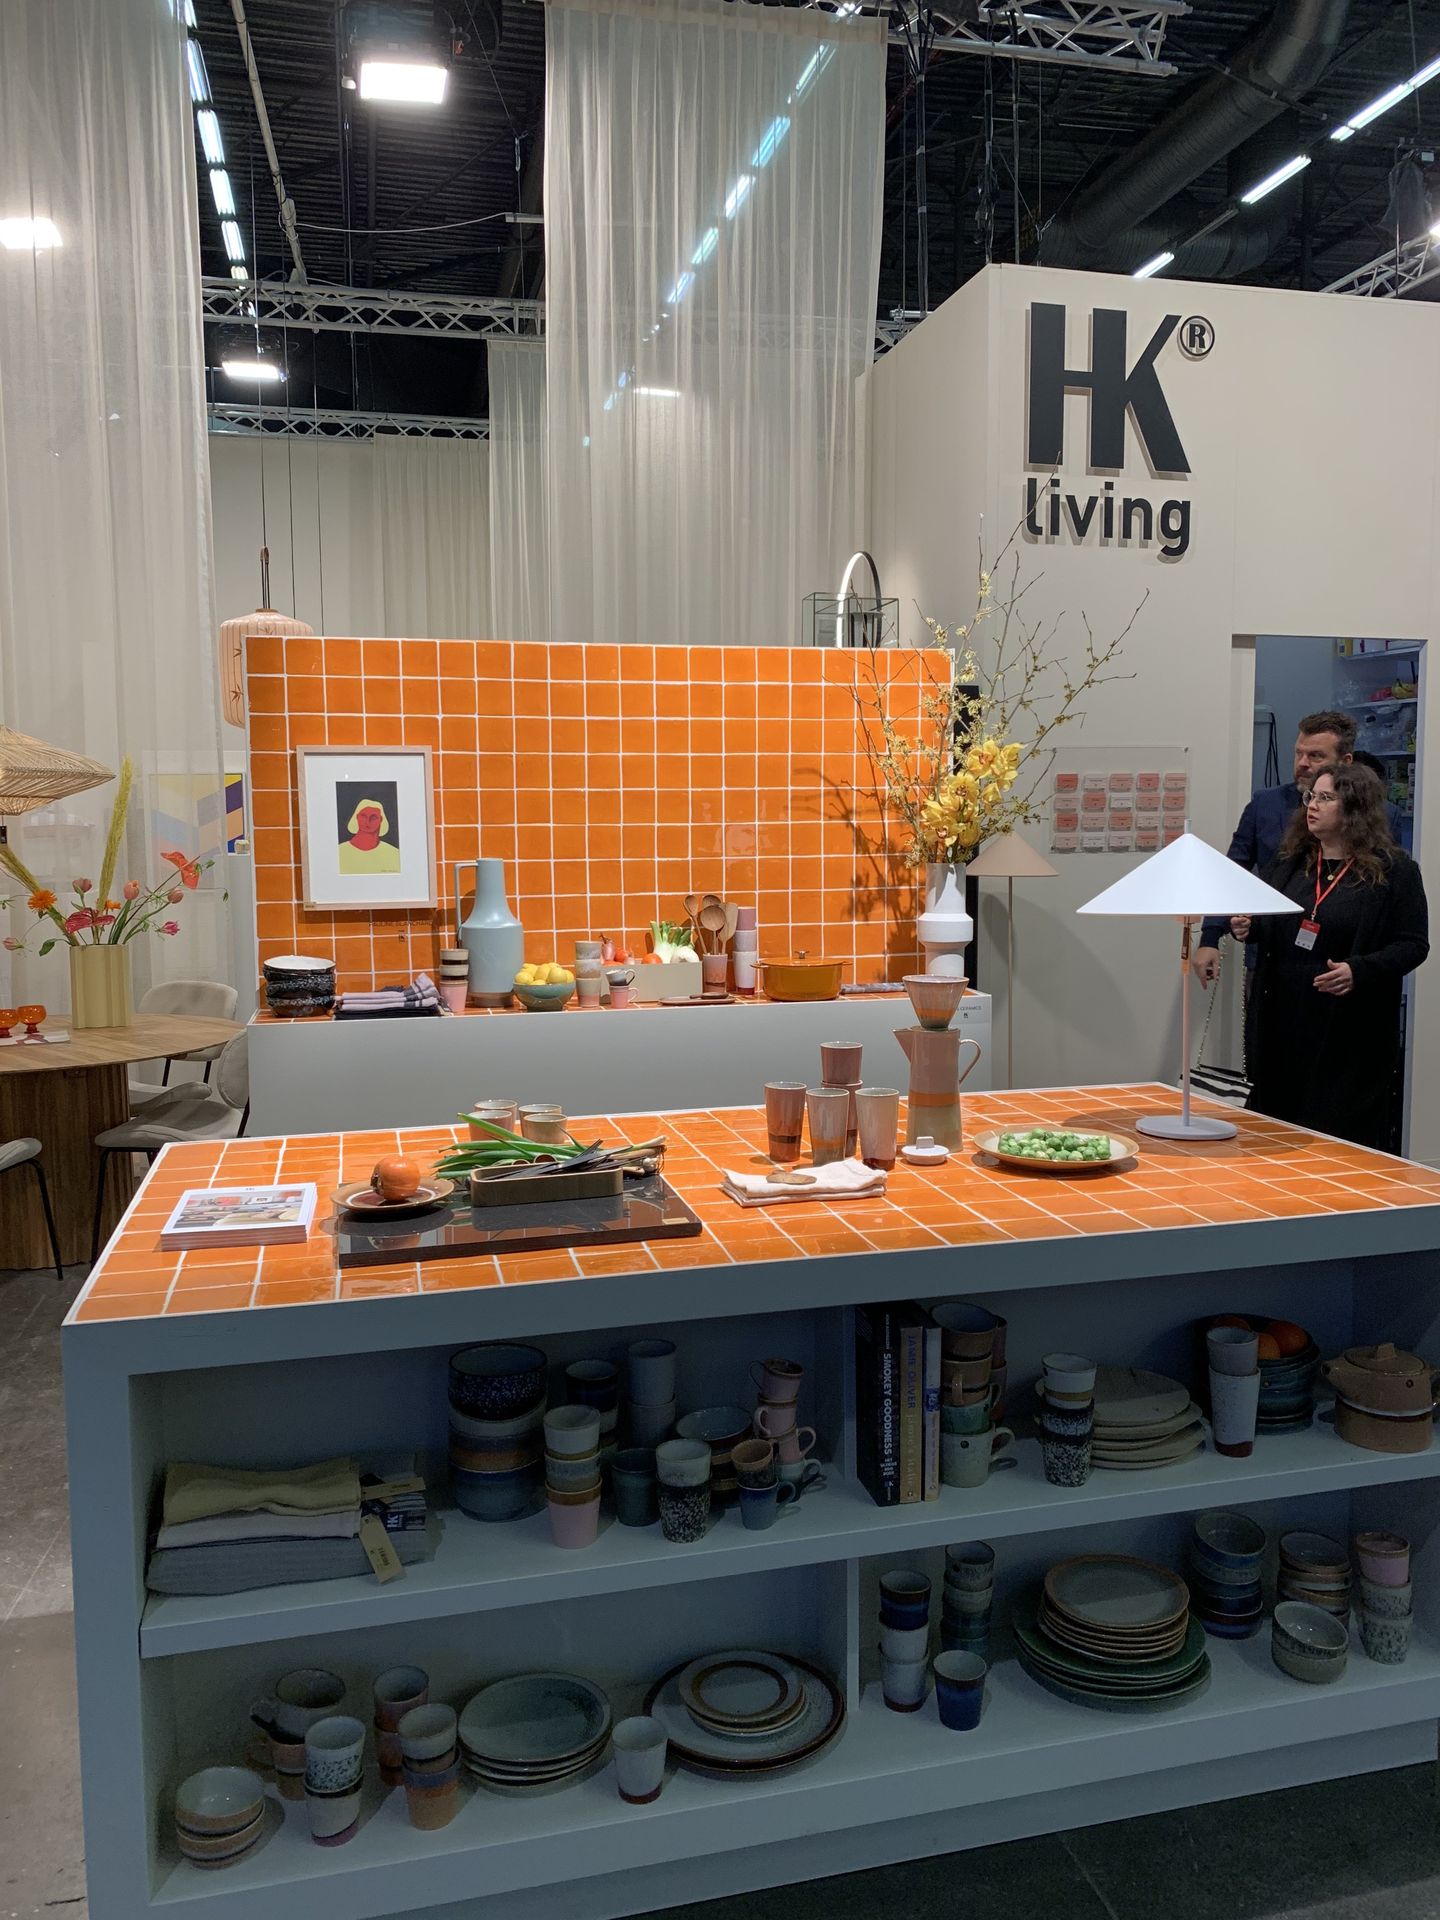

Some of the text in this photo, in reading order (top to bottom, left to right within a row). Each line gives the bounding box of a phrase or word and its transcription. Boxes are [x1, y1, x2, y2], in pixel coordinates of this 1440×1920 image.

[1026, 477, 1191, 556] living
[883, 1353, 892, 1396] SMOKEY
[908, 1370, 917, 1409] OLIVER
[883, 1398, 893, 1455] GOODNESS
